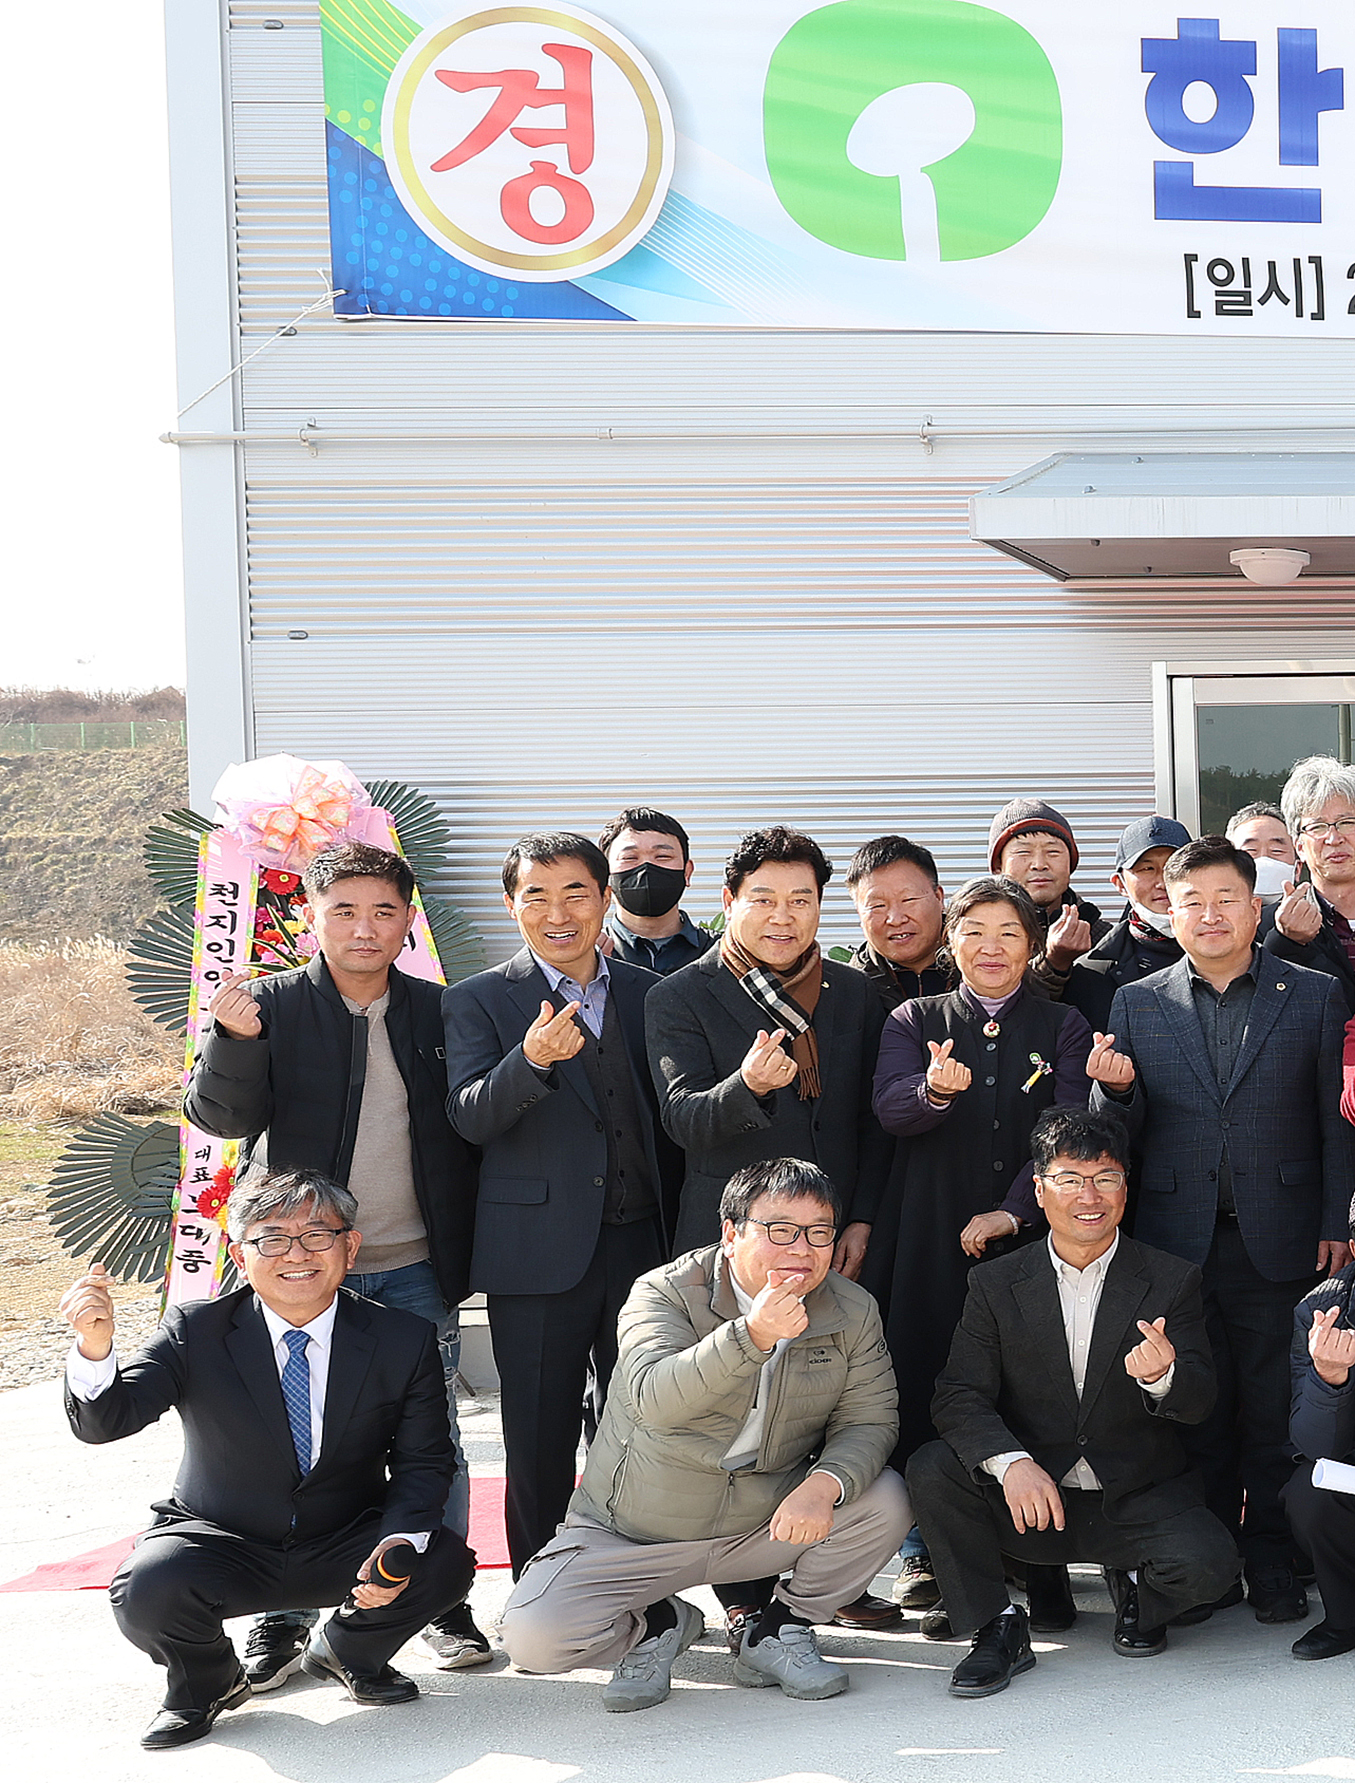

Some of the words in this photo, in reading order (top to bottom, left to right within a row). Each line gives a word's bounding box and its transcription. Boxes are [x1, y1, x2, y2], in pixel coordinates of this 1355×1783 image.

[430, 43, 594, 245] 경
[1183, 254, 1325, 321] [일시]
[189, 1145, 213, 1184] 대표
